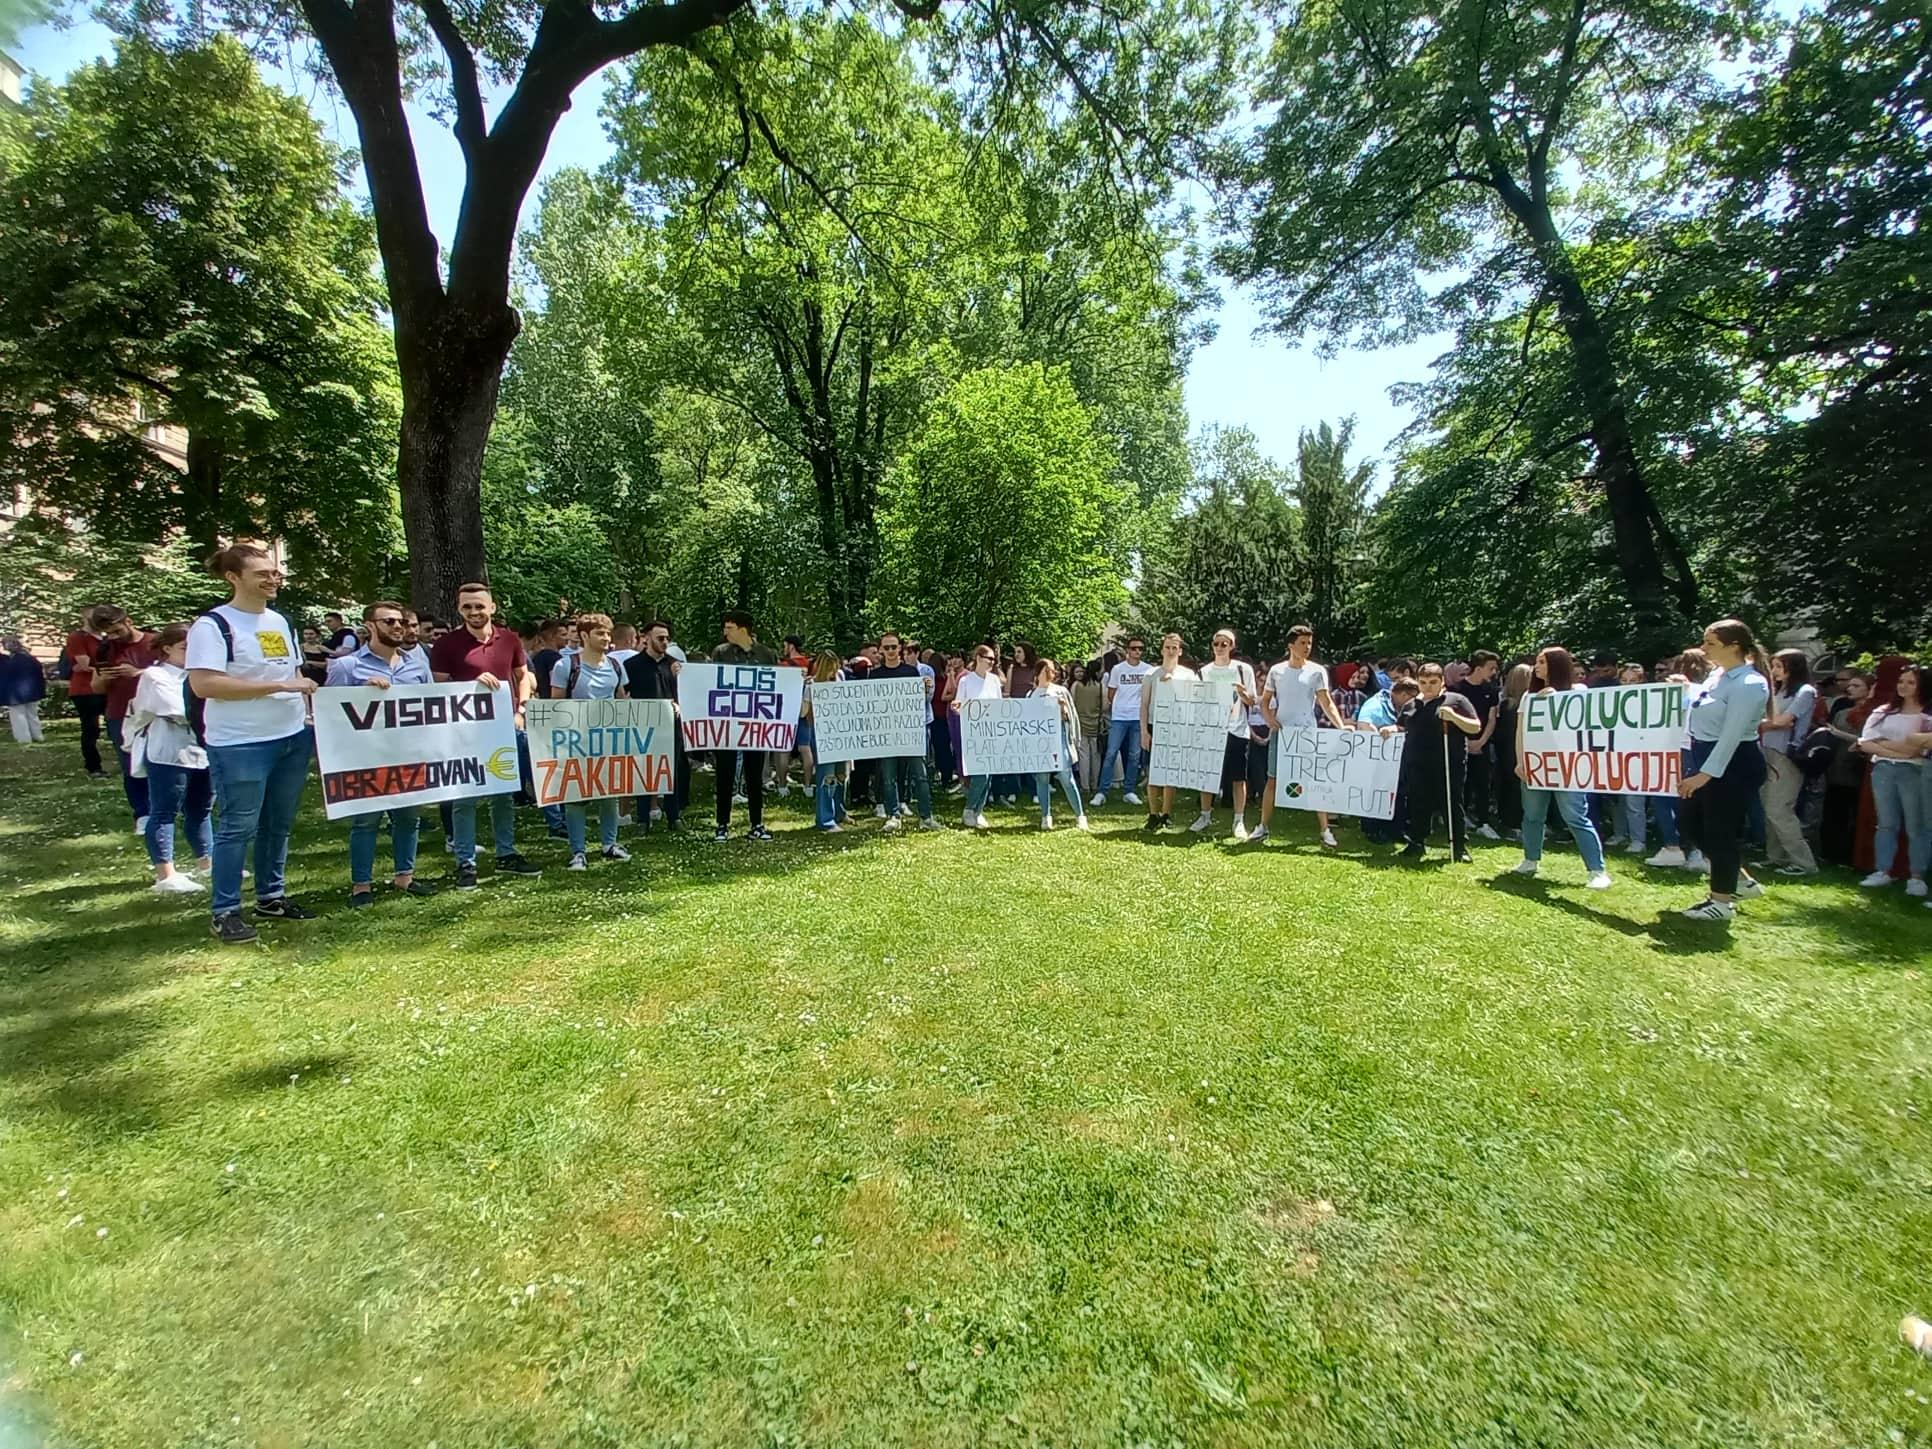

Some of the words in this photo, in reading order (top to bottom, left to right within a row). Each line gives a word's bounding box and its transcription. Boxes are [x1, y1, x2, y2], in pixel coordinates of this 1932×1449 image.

[717, 666, 776, 692] LOŠ
[340, 693, 496, 731] VISOKO
[529, 701, 663, 728] #STUDENTI
[708, 690, 783, 720] GORI
[962, 699, 991, 721] 10%
[1001, 700, 1023, 719] OD
[1527, 686, 1683, 732] EVOLUCIJA
[551, 727, 655, 759] PROTIV
[683, 719, 731, 748] NOVI
[737, 721, 797, 750] ZAKON
[969, 719, 1057, 737] MINISTARSKE
[1280, 725, 1328, 755] VIŠE
[1577, 730, 1615, 752] ILI
[536, 754, 673, 804] ZAKONA
[1525, 752, 1682, 792] REVOLUCIJA
[1347, 785, 1395, 816] PUT!
